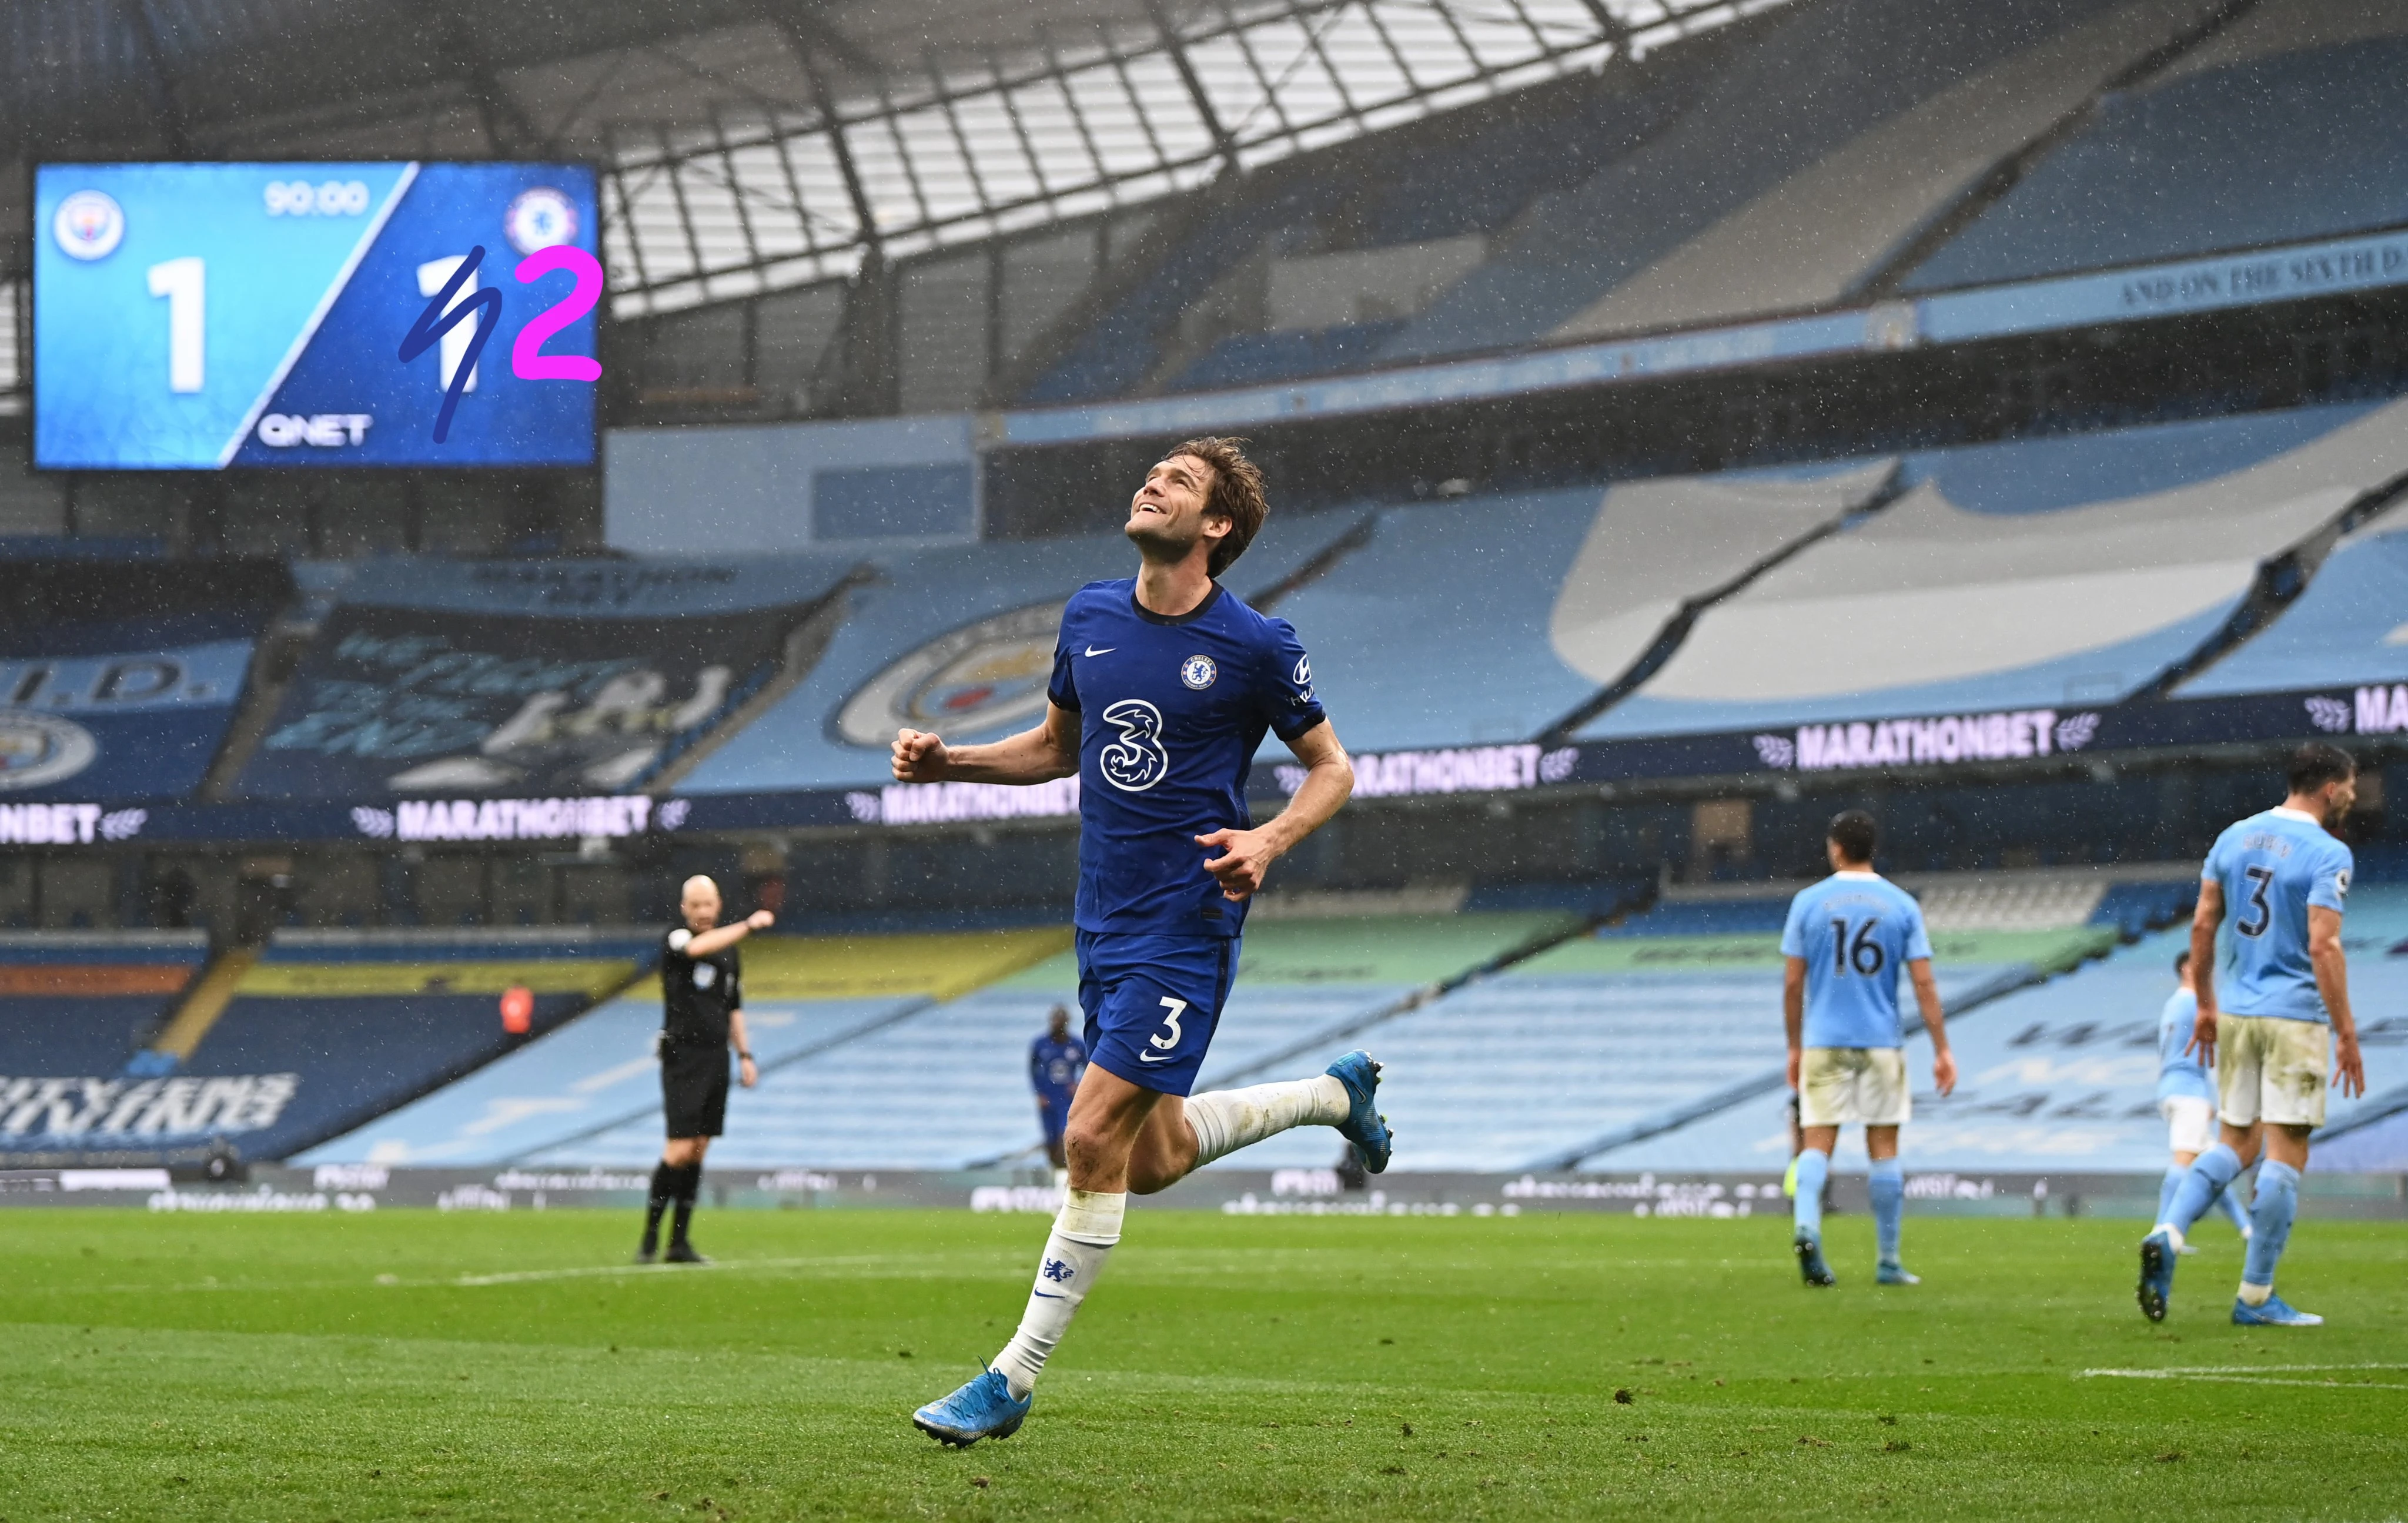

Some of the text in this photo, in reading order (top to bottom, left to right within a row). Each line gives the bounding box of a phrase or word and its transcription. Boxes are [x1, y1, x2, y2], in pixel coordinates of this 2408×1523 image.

[146, 256, 206, 393] 1
[1190, 656, 1213, 667] CHELSEA
[1795, 708, 2058, 769] MARATHONBET
[2236, 865, 2273, 938] 3
[1830, 915, 1885, 976] 16
[1149, 996, 1188, 1050] 3
